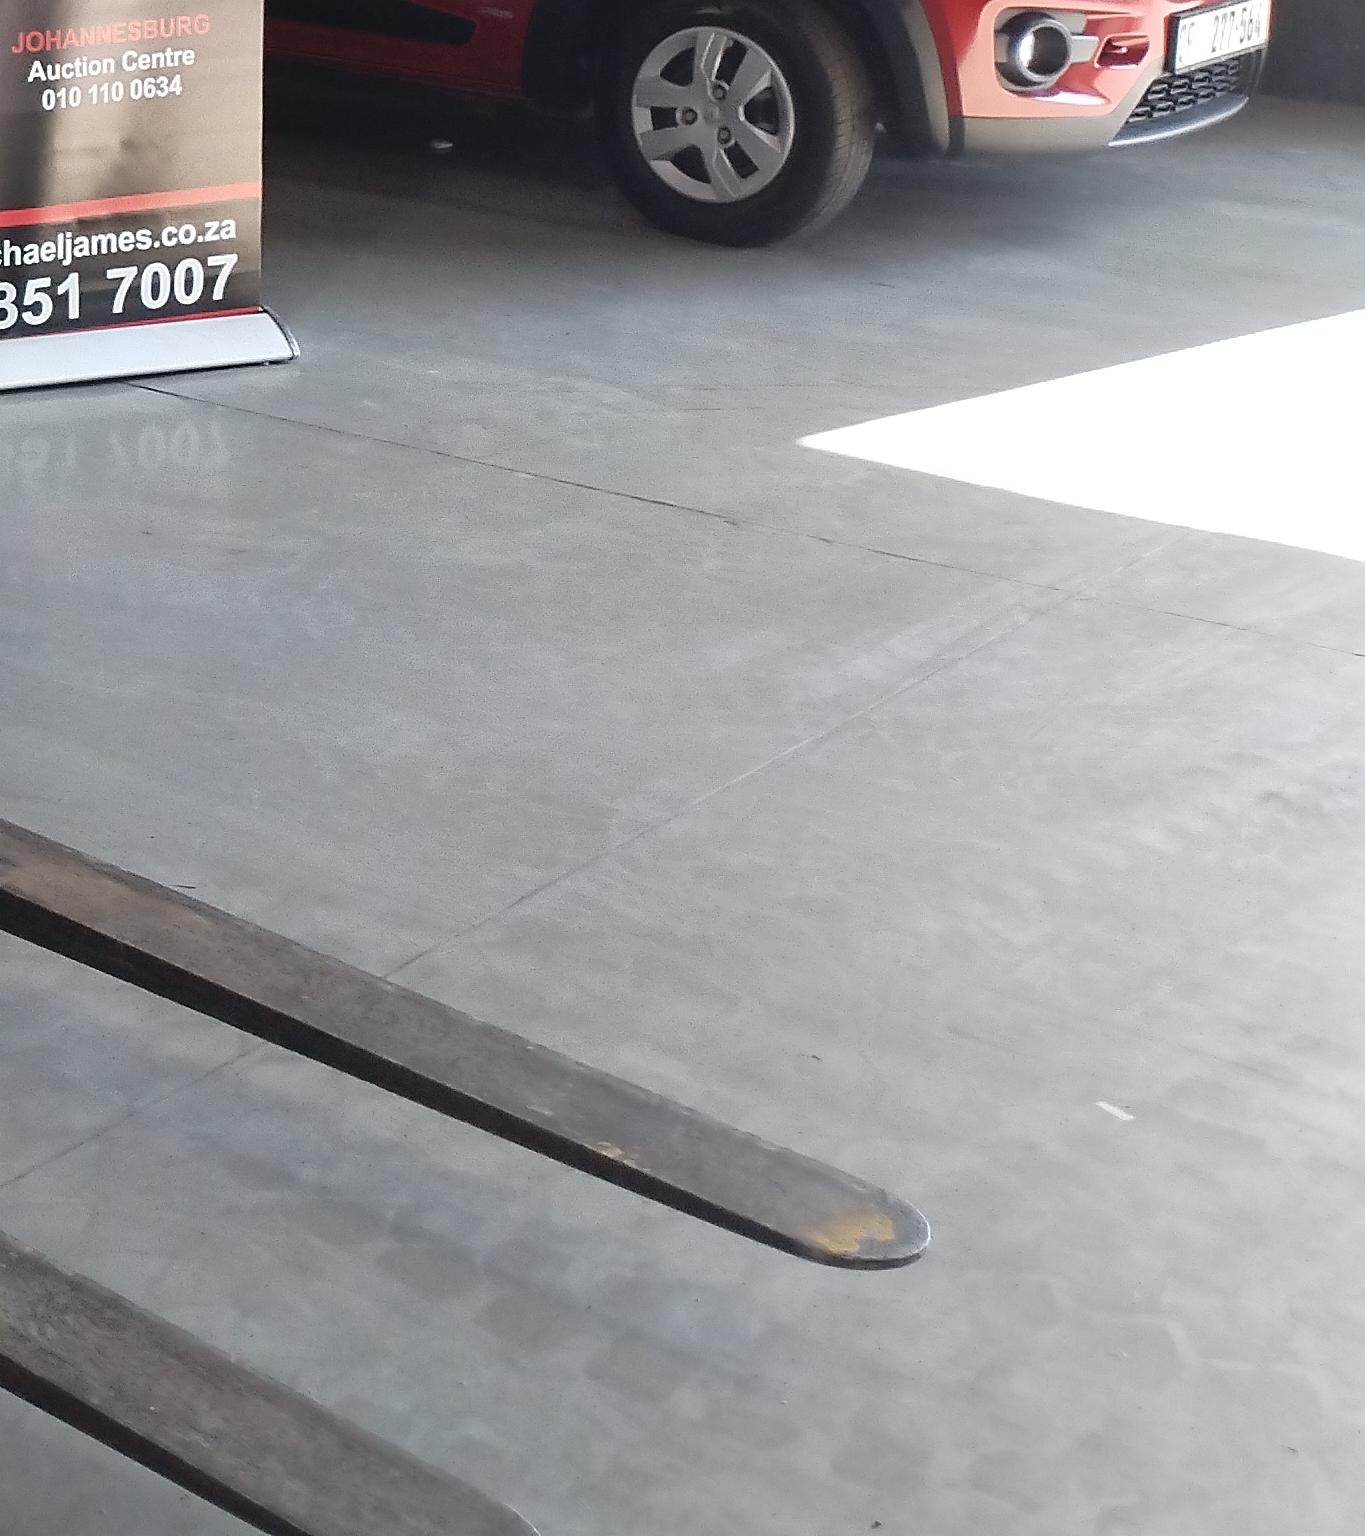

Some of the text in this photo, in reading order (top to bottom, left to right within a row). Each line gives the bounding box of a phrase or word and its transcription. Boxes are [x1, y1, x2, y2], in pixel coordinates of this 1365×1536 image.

[11, 14, 210, 53] JOHANNESBURG
[28, 48, 194, 83] Auction Centre
[42, 75, 182, 111] 010 110 0634
[106, 254, 238, 314] 7007
